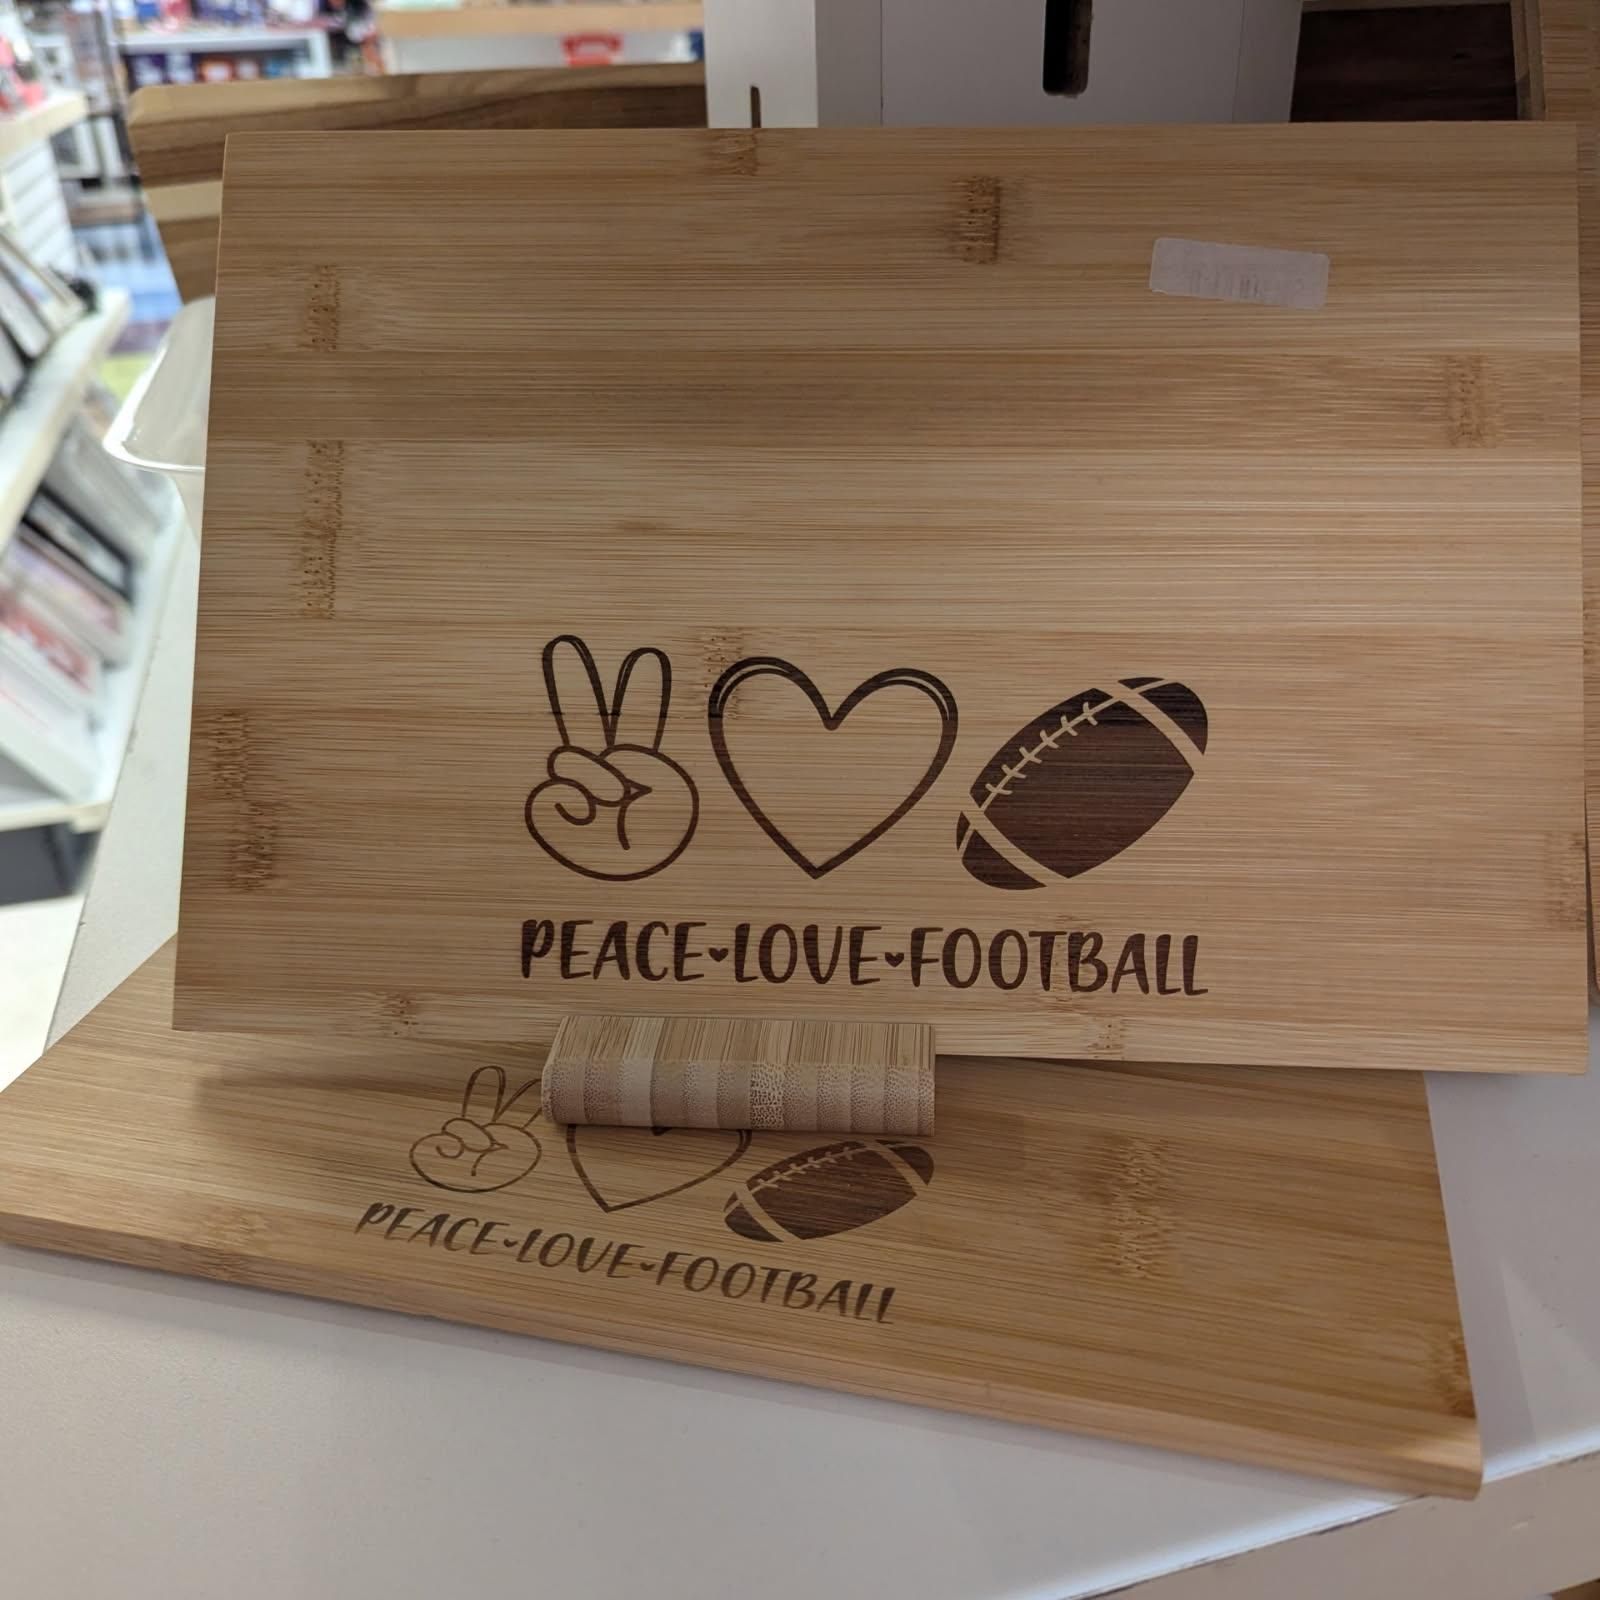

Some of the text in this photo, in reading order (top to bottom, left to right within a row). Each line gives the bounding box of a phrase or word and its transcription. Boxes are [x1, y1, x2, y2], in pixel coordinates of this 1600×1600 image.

[520, 919, 1208, 995] PEACE LOVE FOOTBALL
[354, 1202, 895, 1324] PEACE LOVE FOOTBALL
